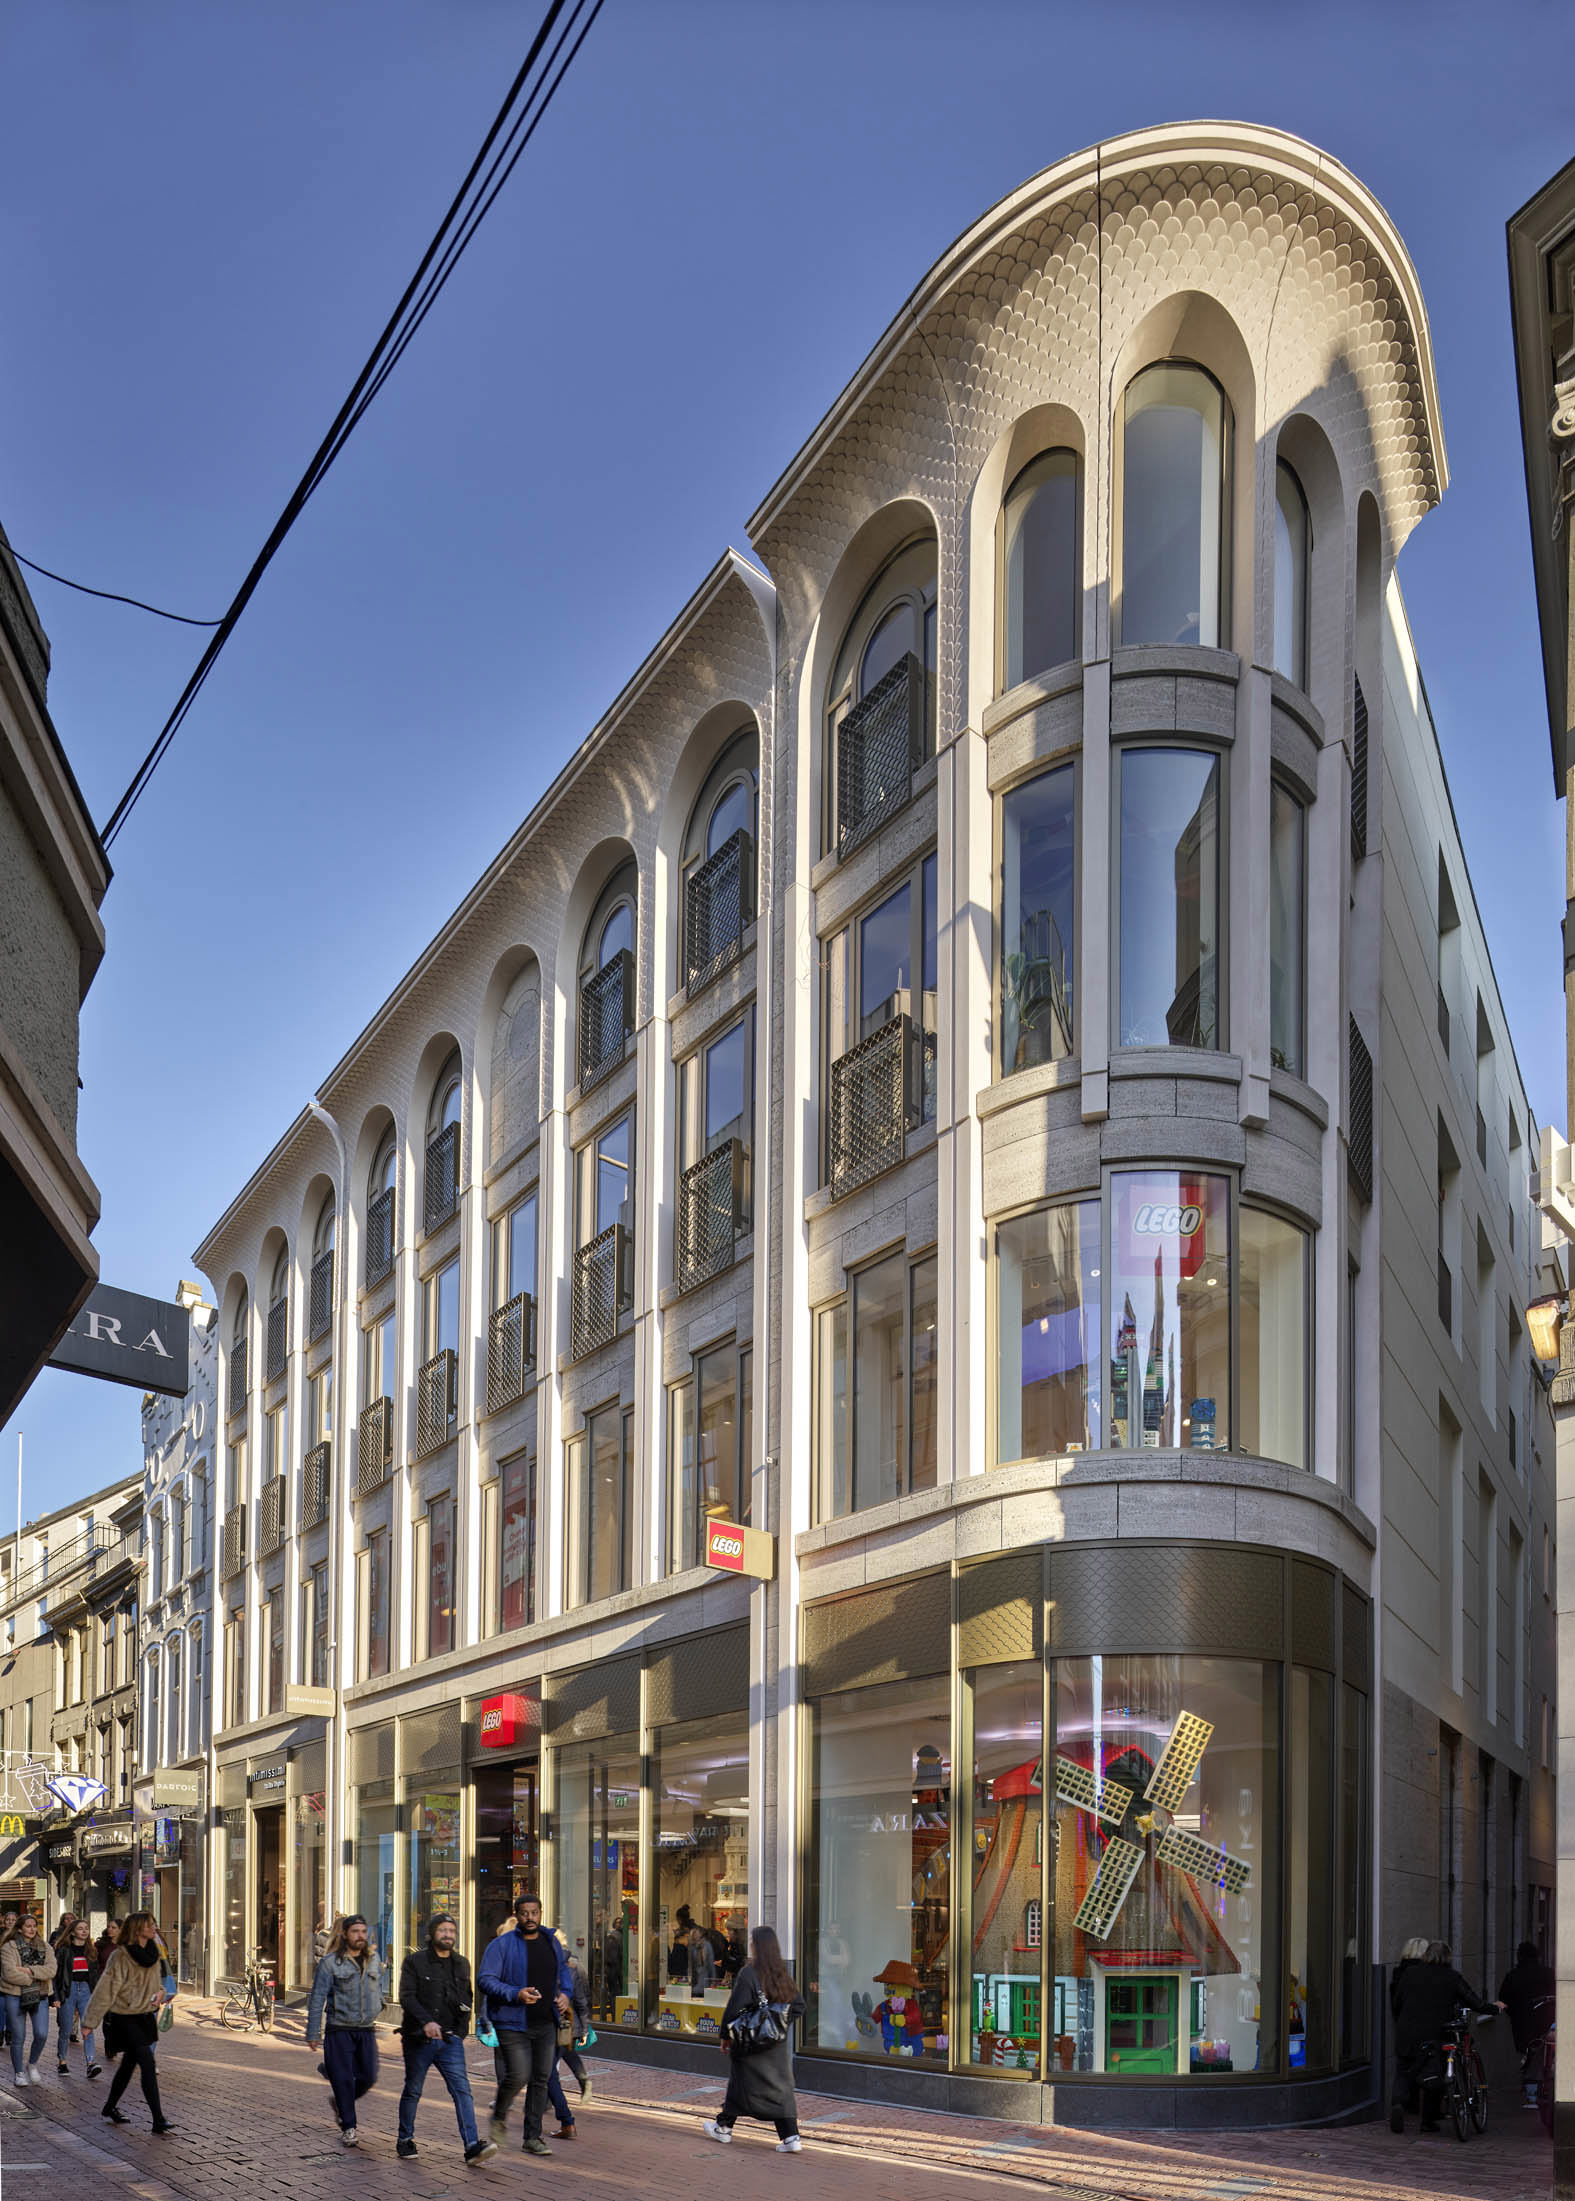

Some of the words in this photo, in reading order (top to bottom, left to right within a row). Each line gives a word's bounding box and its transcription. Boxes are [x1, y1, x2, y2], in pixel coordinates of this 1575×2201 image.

[1134, 1205, 1202, 1236] LEGO
[67, 1310, 174, 1359] RA
[711, 1535, 742, 1557] LEGO
[483, 1710, 502, 1731] LEGO
